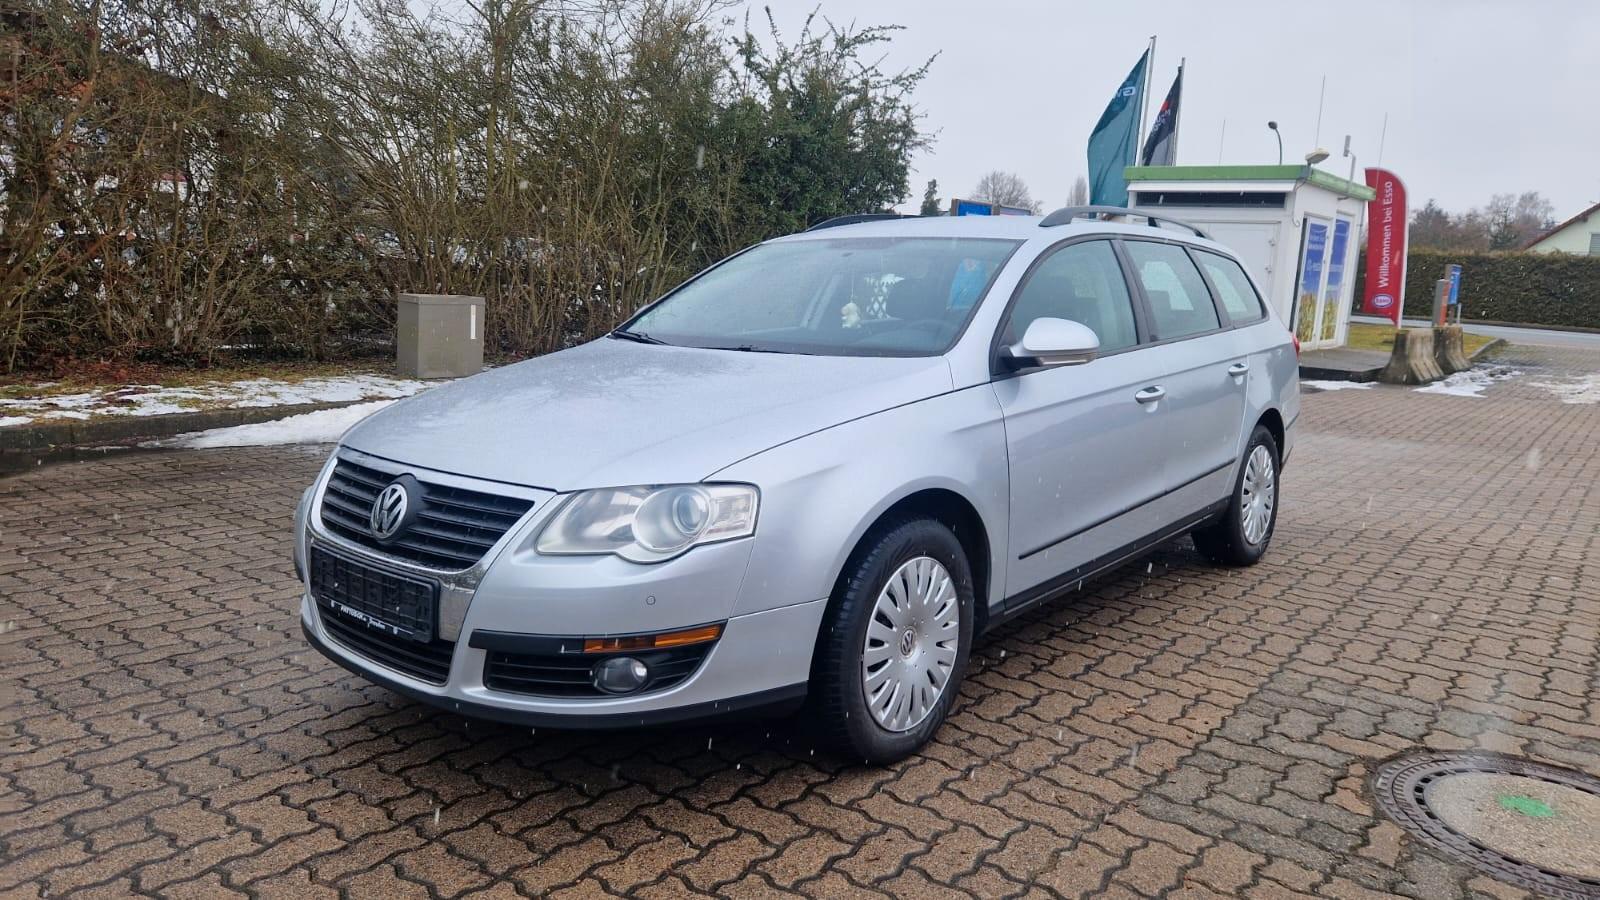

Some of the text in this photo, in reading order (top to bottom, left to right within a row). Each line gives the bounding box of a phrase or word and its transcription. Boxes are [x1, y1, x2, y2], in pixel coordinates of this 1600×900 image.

[1377, 181, 1393, 288] Willkommen bei Esso
[372, 484, 406, 537] VW
